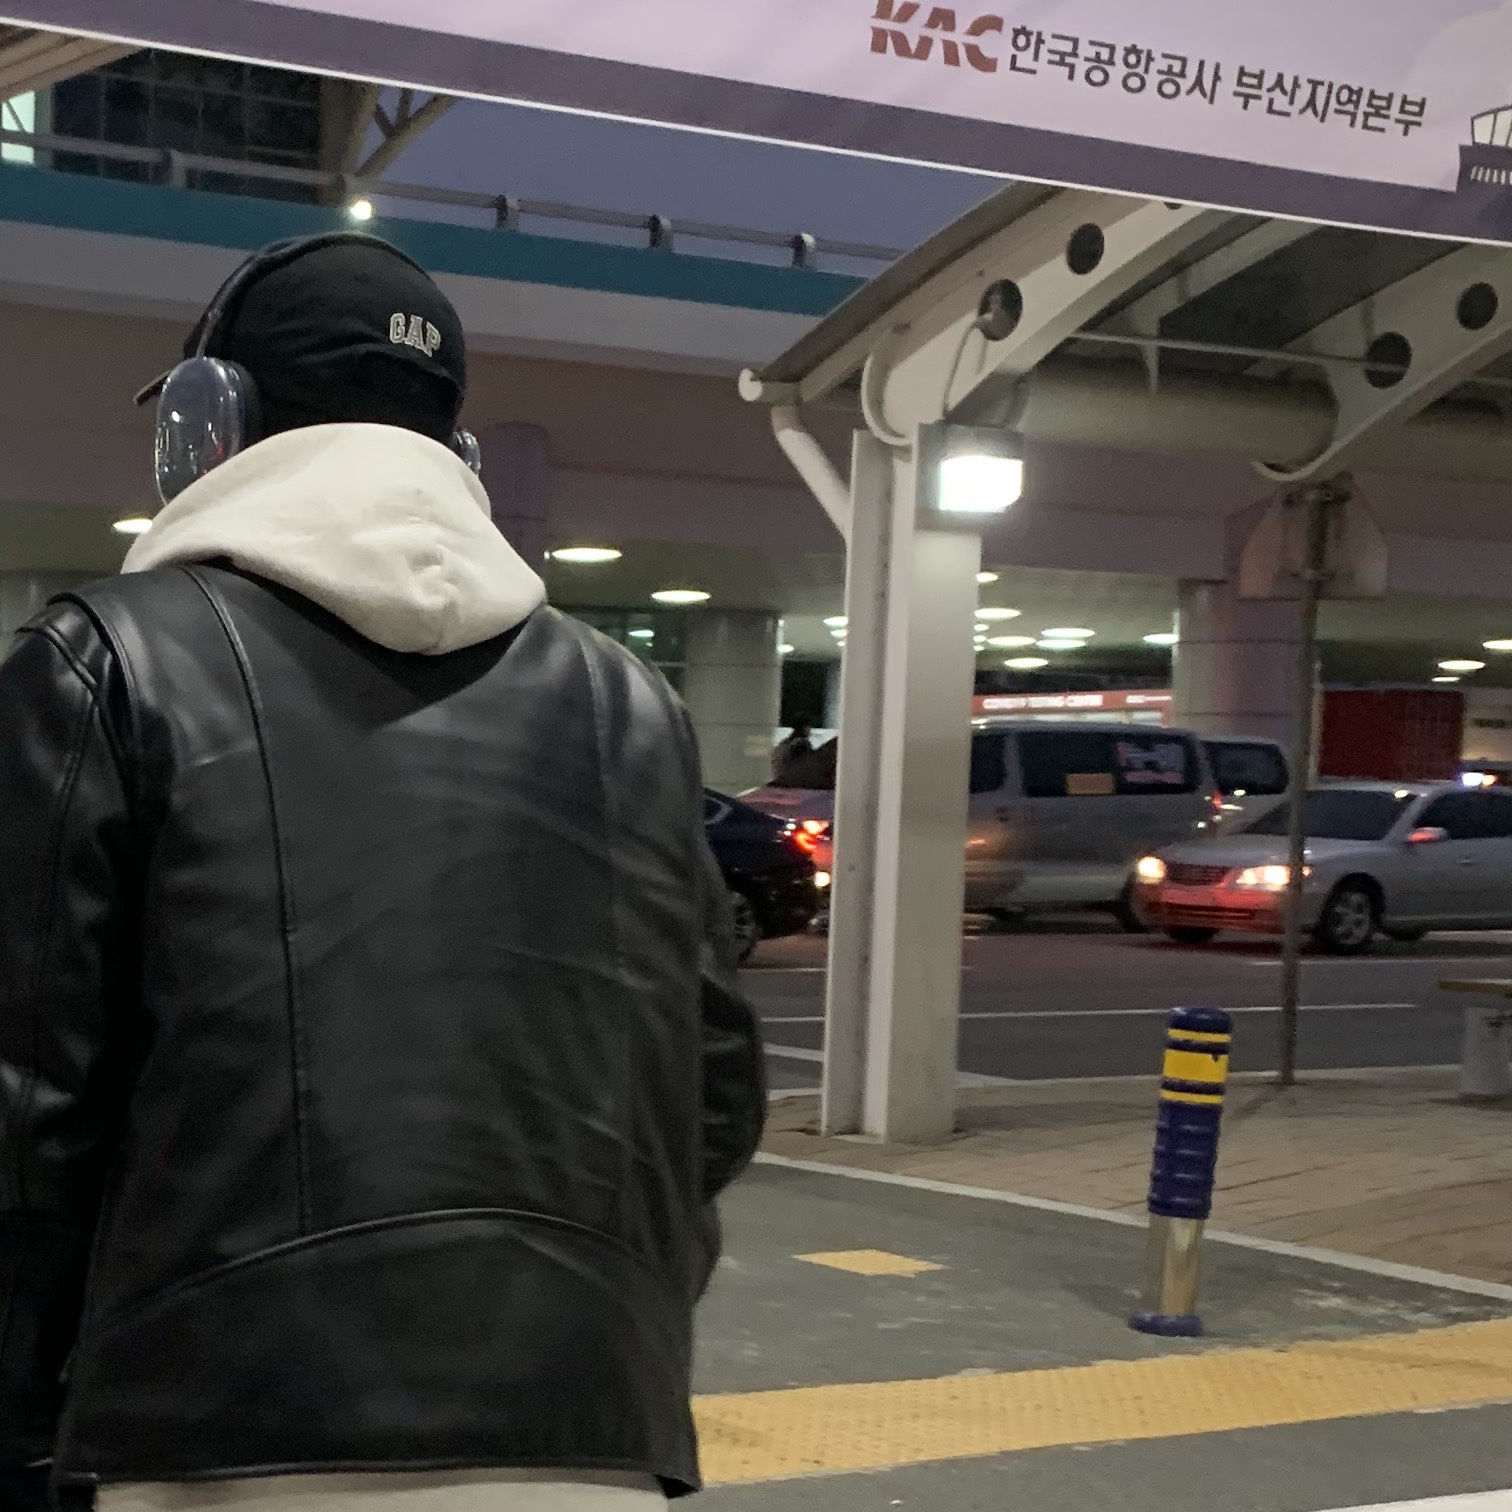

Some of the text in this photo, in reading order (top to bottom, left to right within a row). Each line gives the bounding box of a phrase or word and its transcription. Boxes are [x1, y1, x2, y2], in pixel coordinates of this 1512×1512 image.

[869, 0, 1427, 137] KAC 한국공항공사 부산지역본부
[389, 312, 441, 358] GAP
